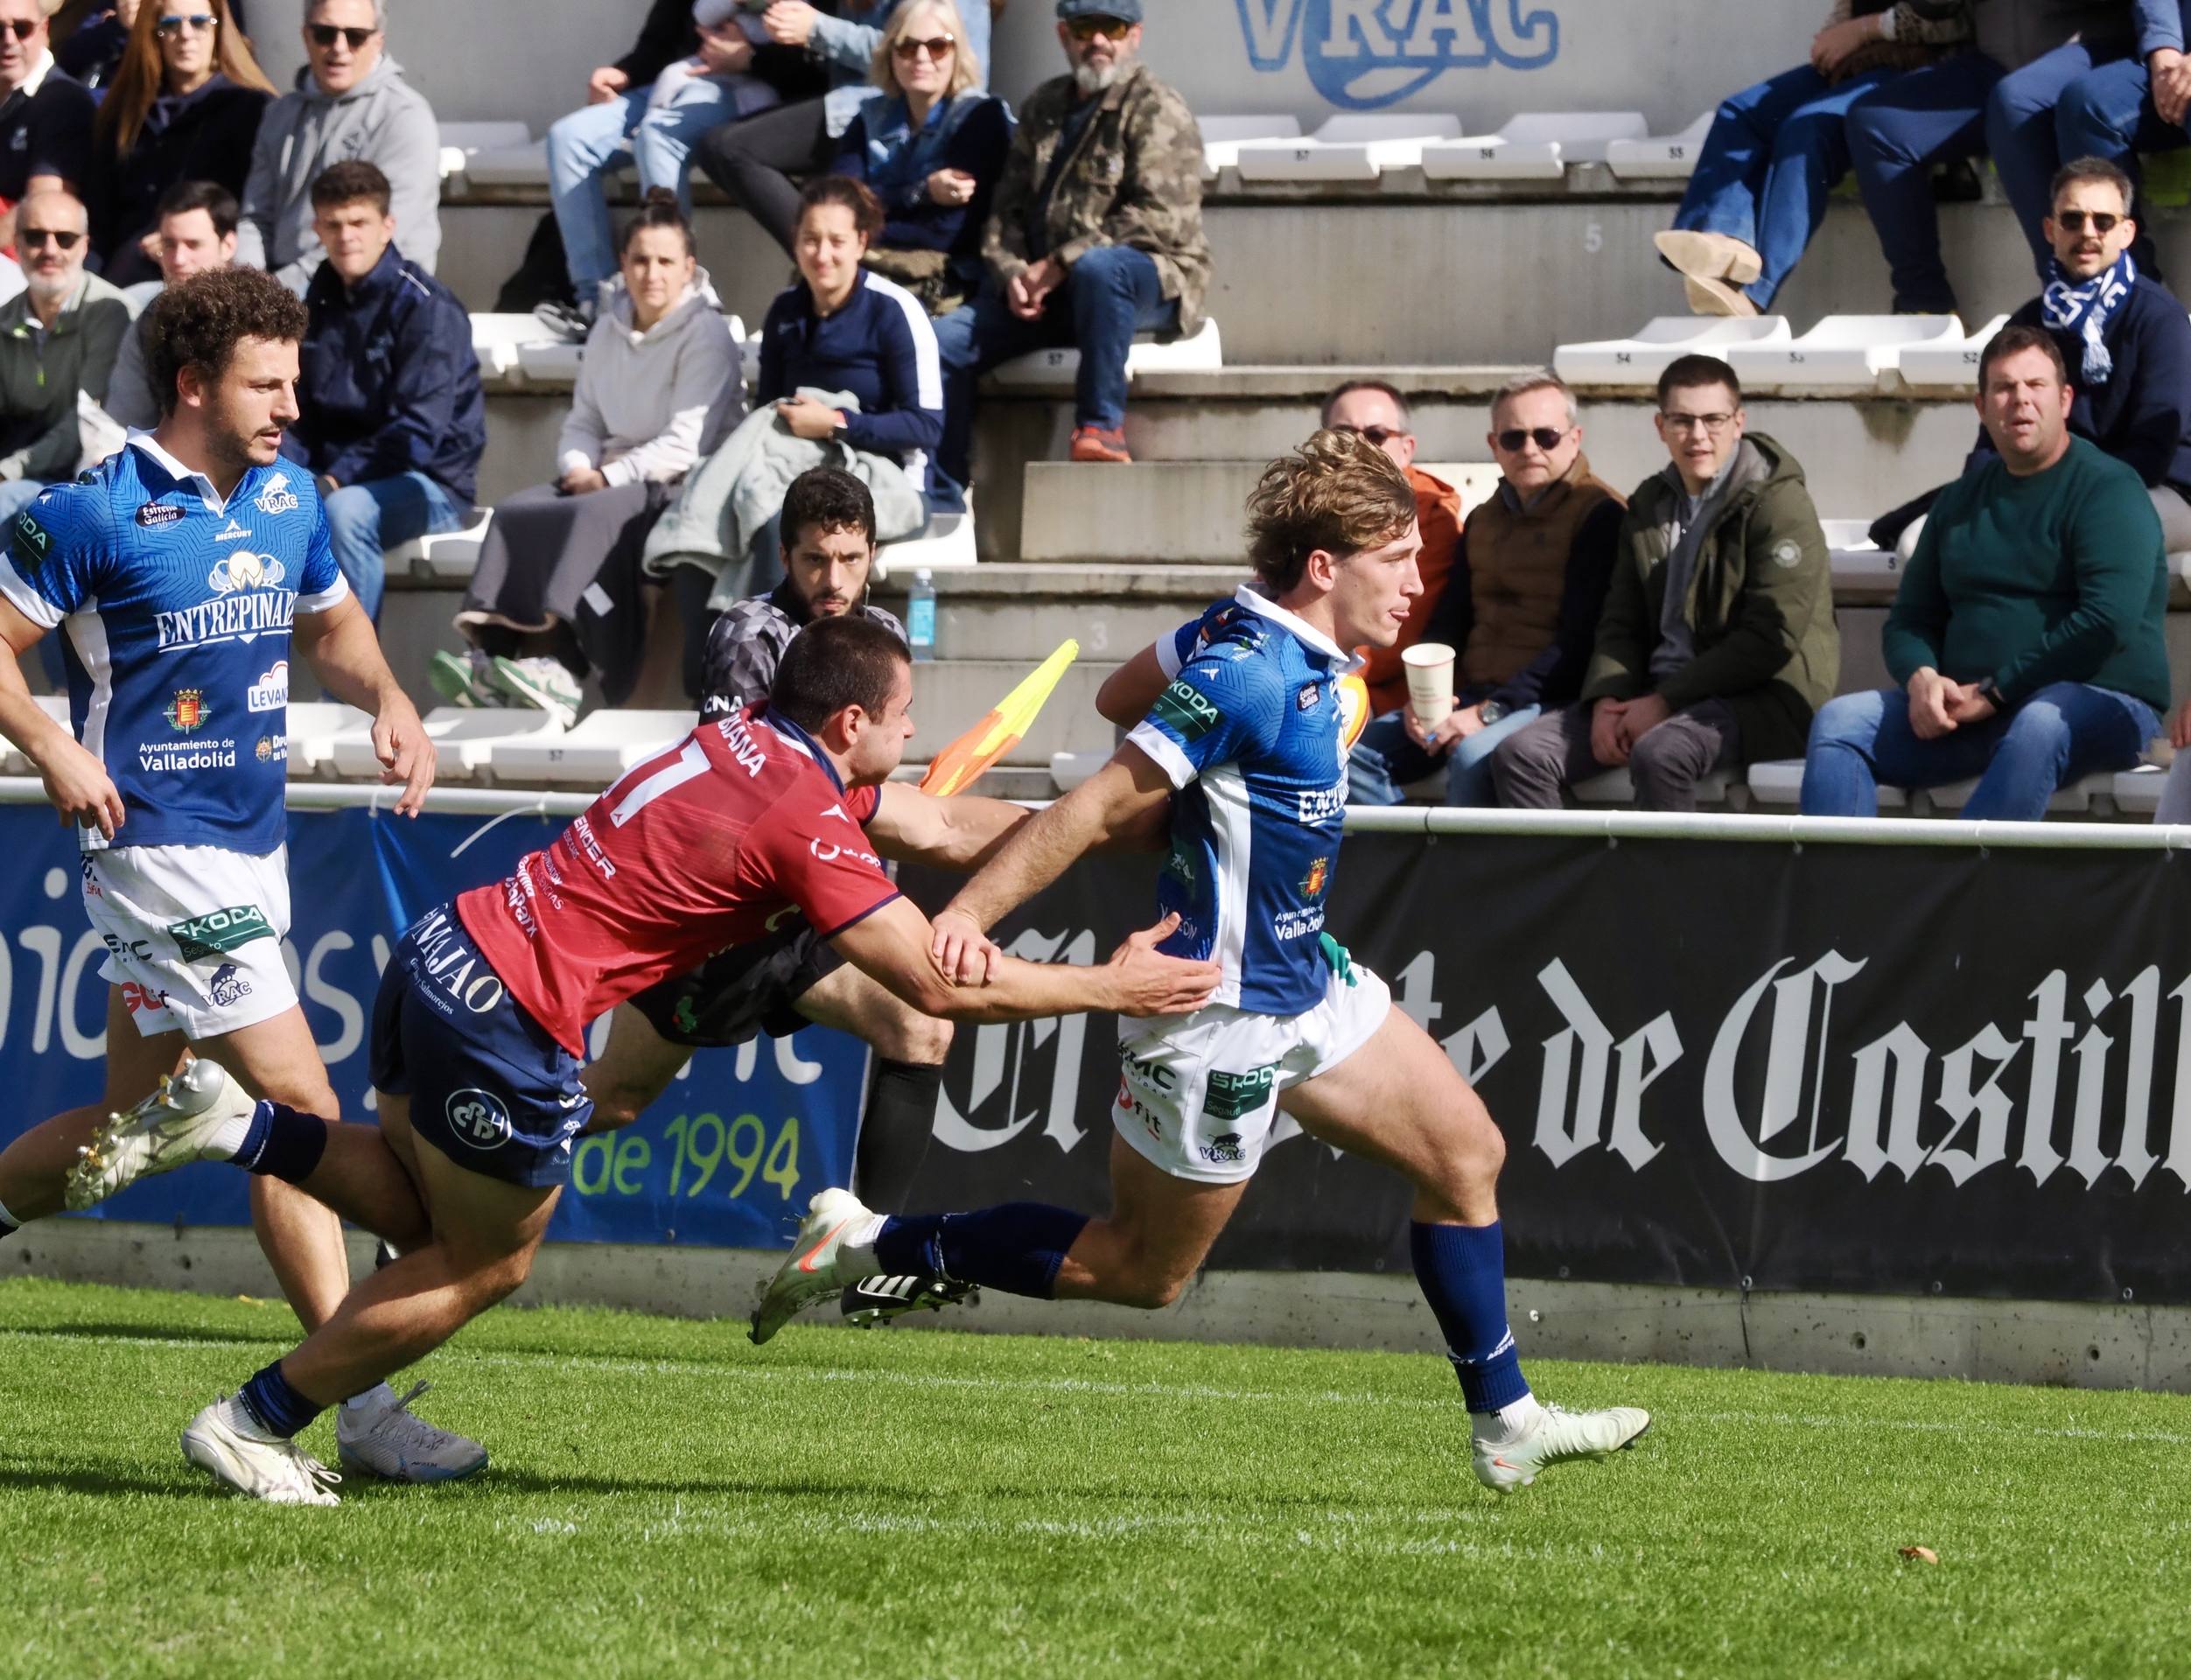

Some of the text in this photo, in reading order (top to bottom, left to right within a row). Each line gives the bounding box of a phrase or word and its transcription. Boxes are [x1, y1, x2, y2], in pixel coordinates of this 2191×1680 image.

[1236, 0, 1560, 72] VRAC
[1585, 223, 1602, 253] 5
[254, 495, 299, 516] VRAC
[144, 512, 178, 525] Galicia
[215, 529, 253, 542] MERCURY
[139, 738, 234, 753] Ayuntamiento de
[140, 750, 236, 772] Valladolid
[202, 981, 252, 1007] VRAC
[1531, 956, 1684, 1172] de
[663, 1113, 800, 1200] 1994
[1200, 1146, 1246, 1165] VRAC
